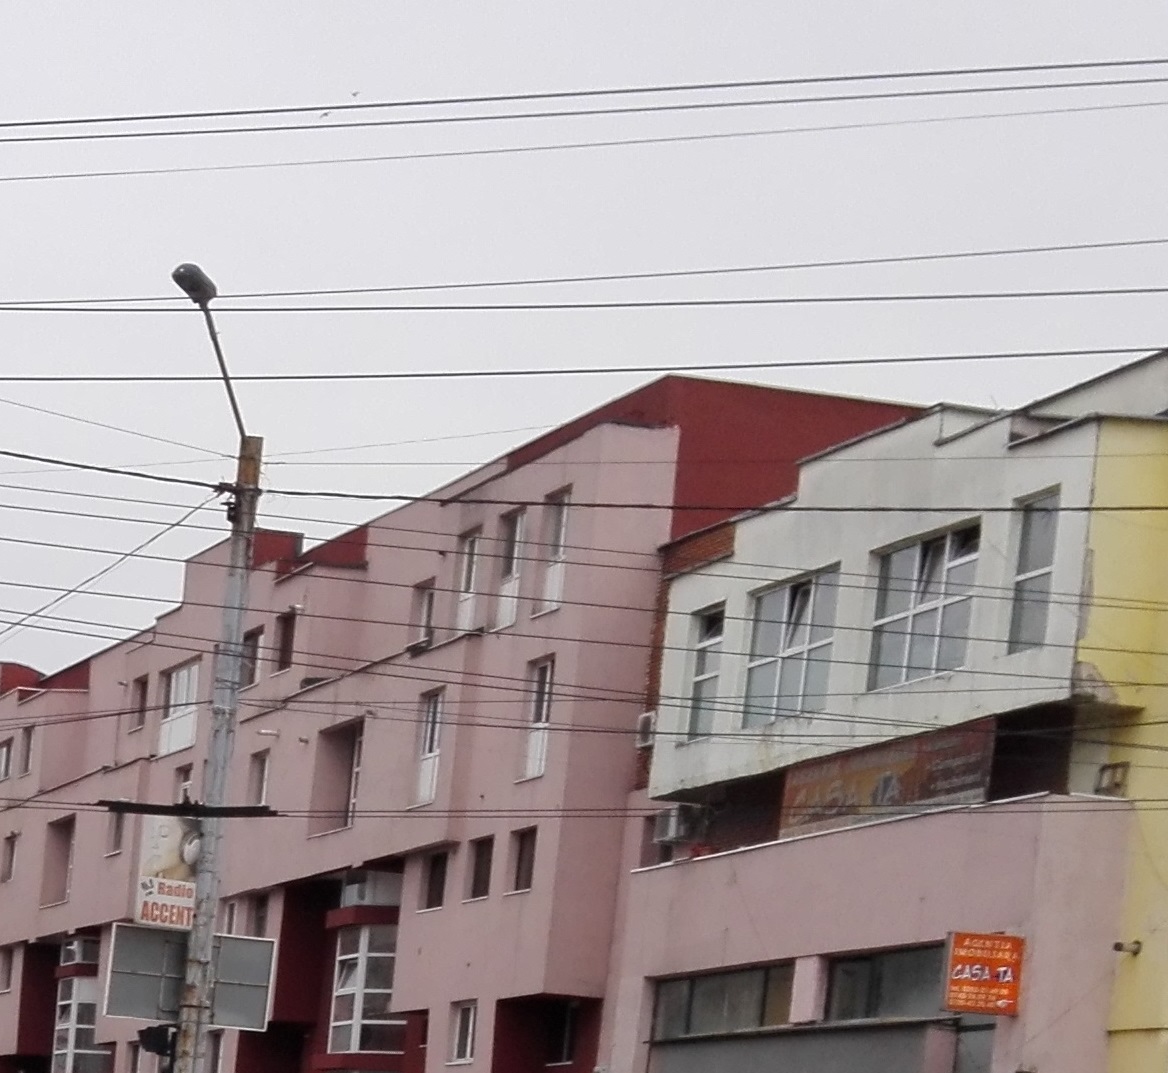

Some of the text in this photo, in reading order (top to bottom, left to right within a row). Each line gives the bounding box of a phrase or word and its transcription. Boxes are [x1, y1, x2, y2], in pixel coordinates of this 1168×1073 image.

[157, 882, 193, 899] Radio
[140, 900, 193, 927] ACCENT
[951, 964, 1014, 982] CASA TA
